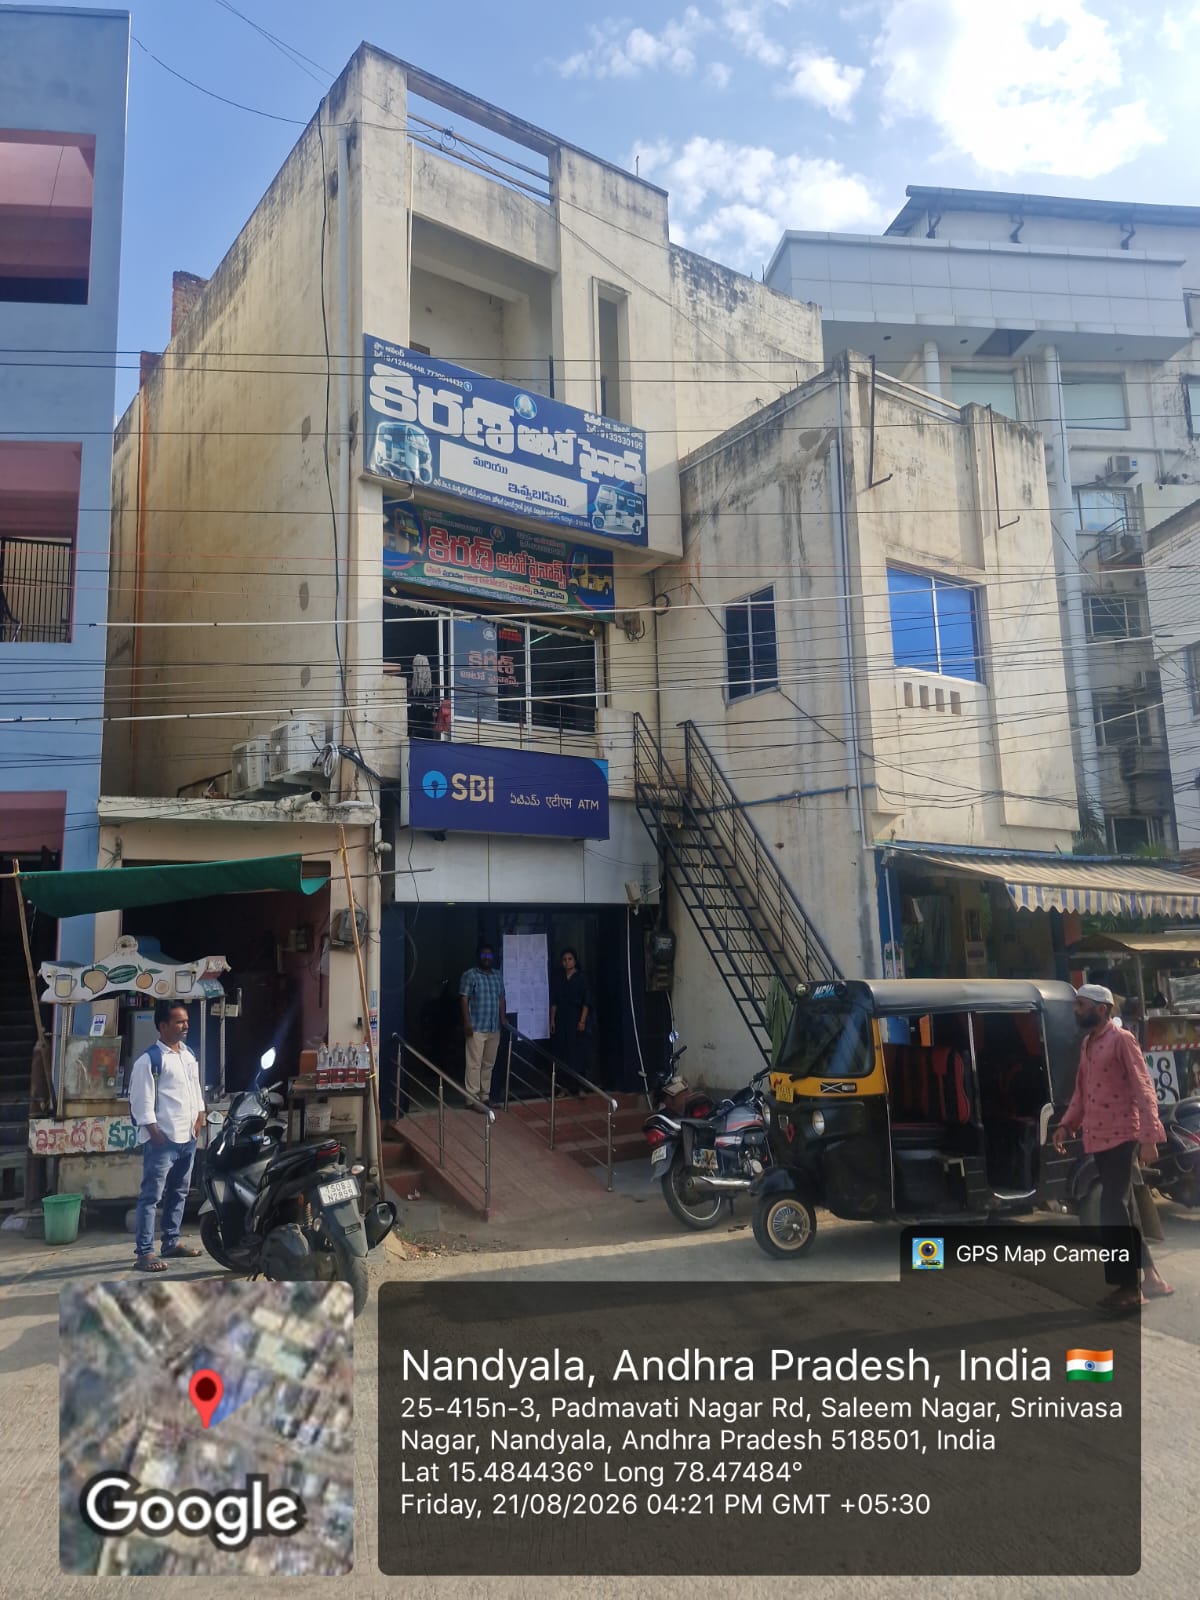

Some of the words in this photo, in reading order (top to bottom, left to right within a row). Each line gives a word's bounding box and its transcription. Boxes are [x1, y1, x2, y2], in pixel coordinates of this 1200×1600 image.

[473, 456, 508, 475] మరియు
[428, 526, 495, 572] కిరణ్
[496, 551, 527, 577] ఆటో
[527, 556, 567, 589] ఫైనాన్స్
[451, 772, 494, 803] SBI
[545, 793, 573, 810] एटीएम
[578, 799, 600, 810] ATM
